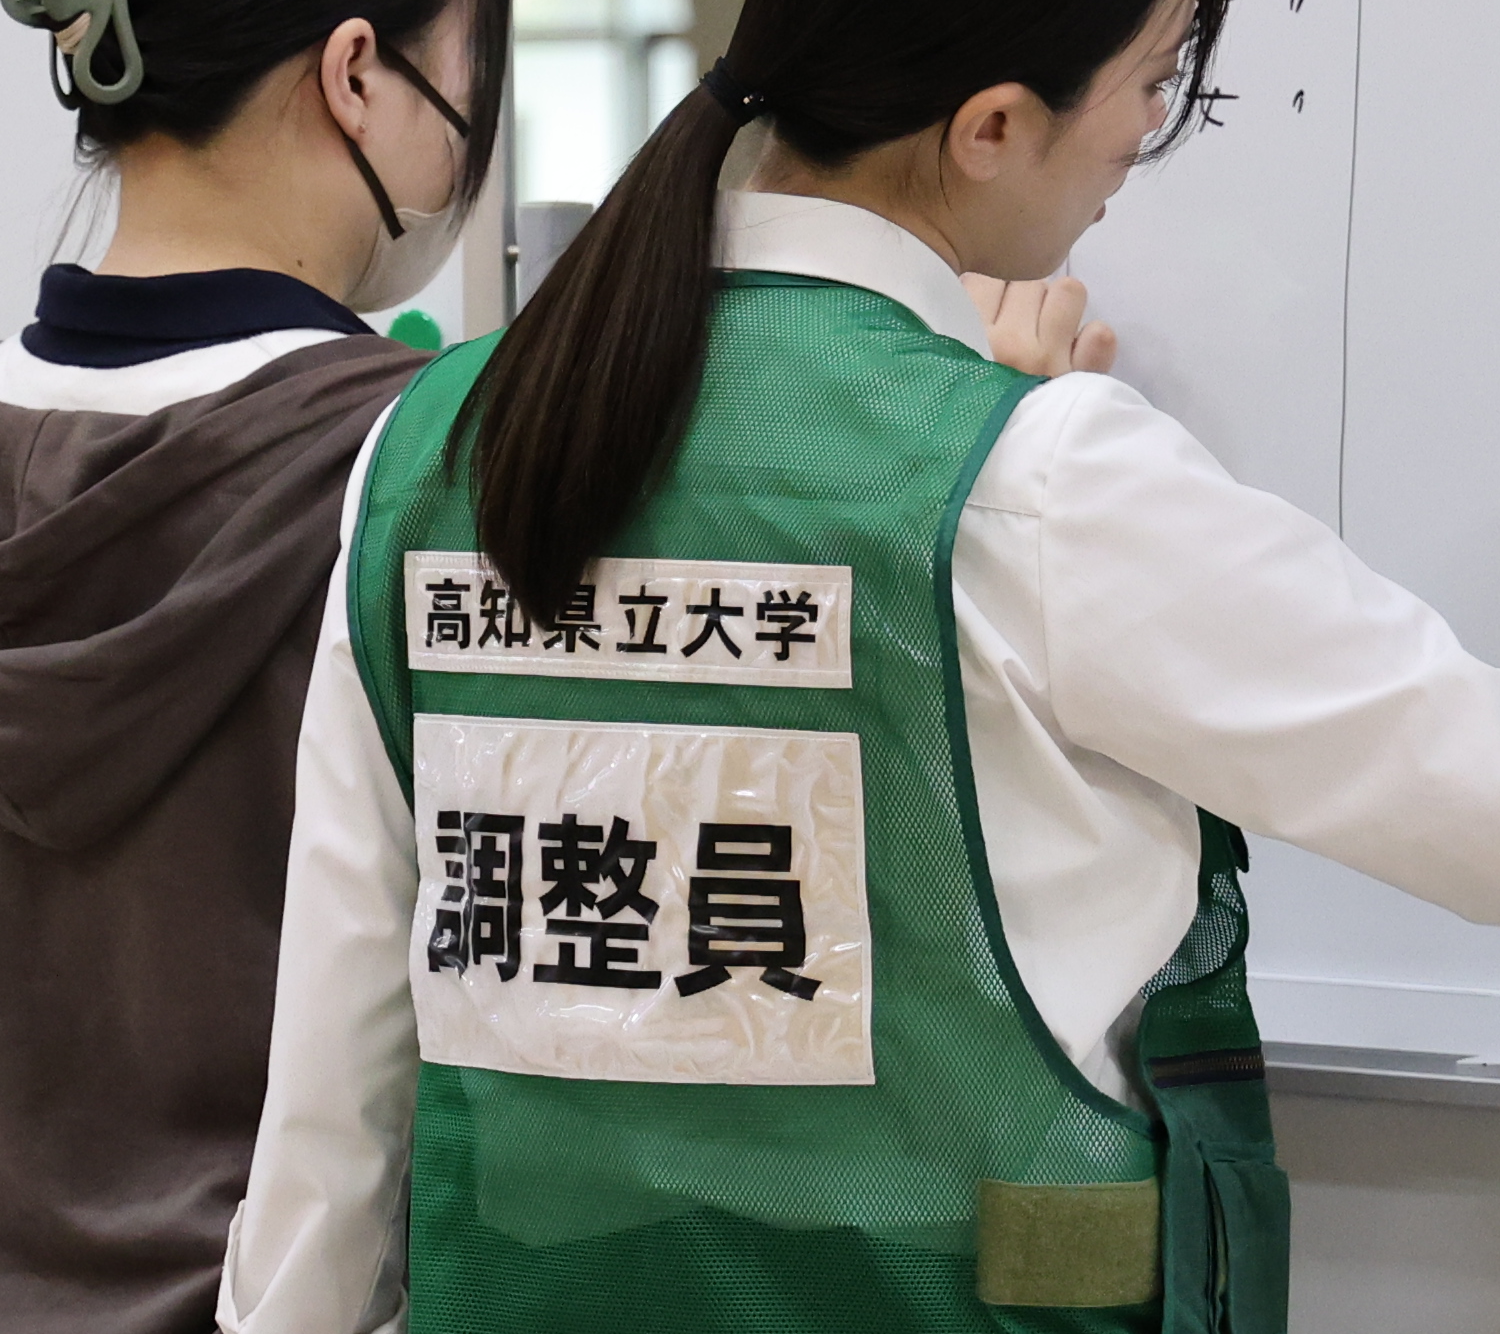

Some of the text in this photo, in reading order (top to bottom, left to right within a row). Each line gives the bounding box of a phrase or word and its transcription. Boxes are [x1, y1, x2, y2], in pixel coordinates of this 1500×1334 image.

[424, 578, 819, 662] 高知県立大学
[427, 809, 823, 1001] 調整員
